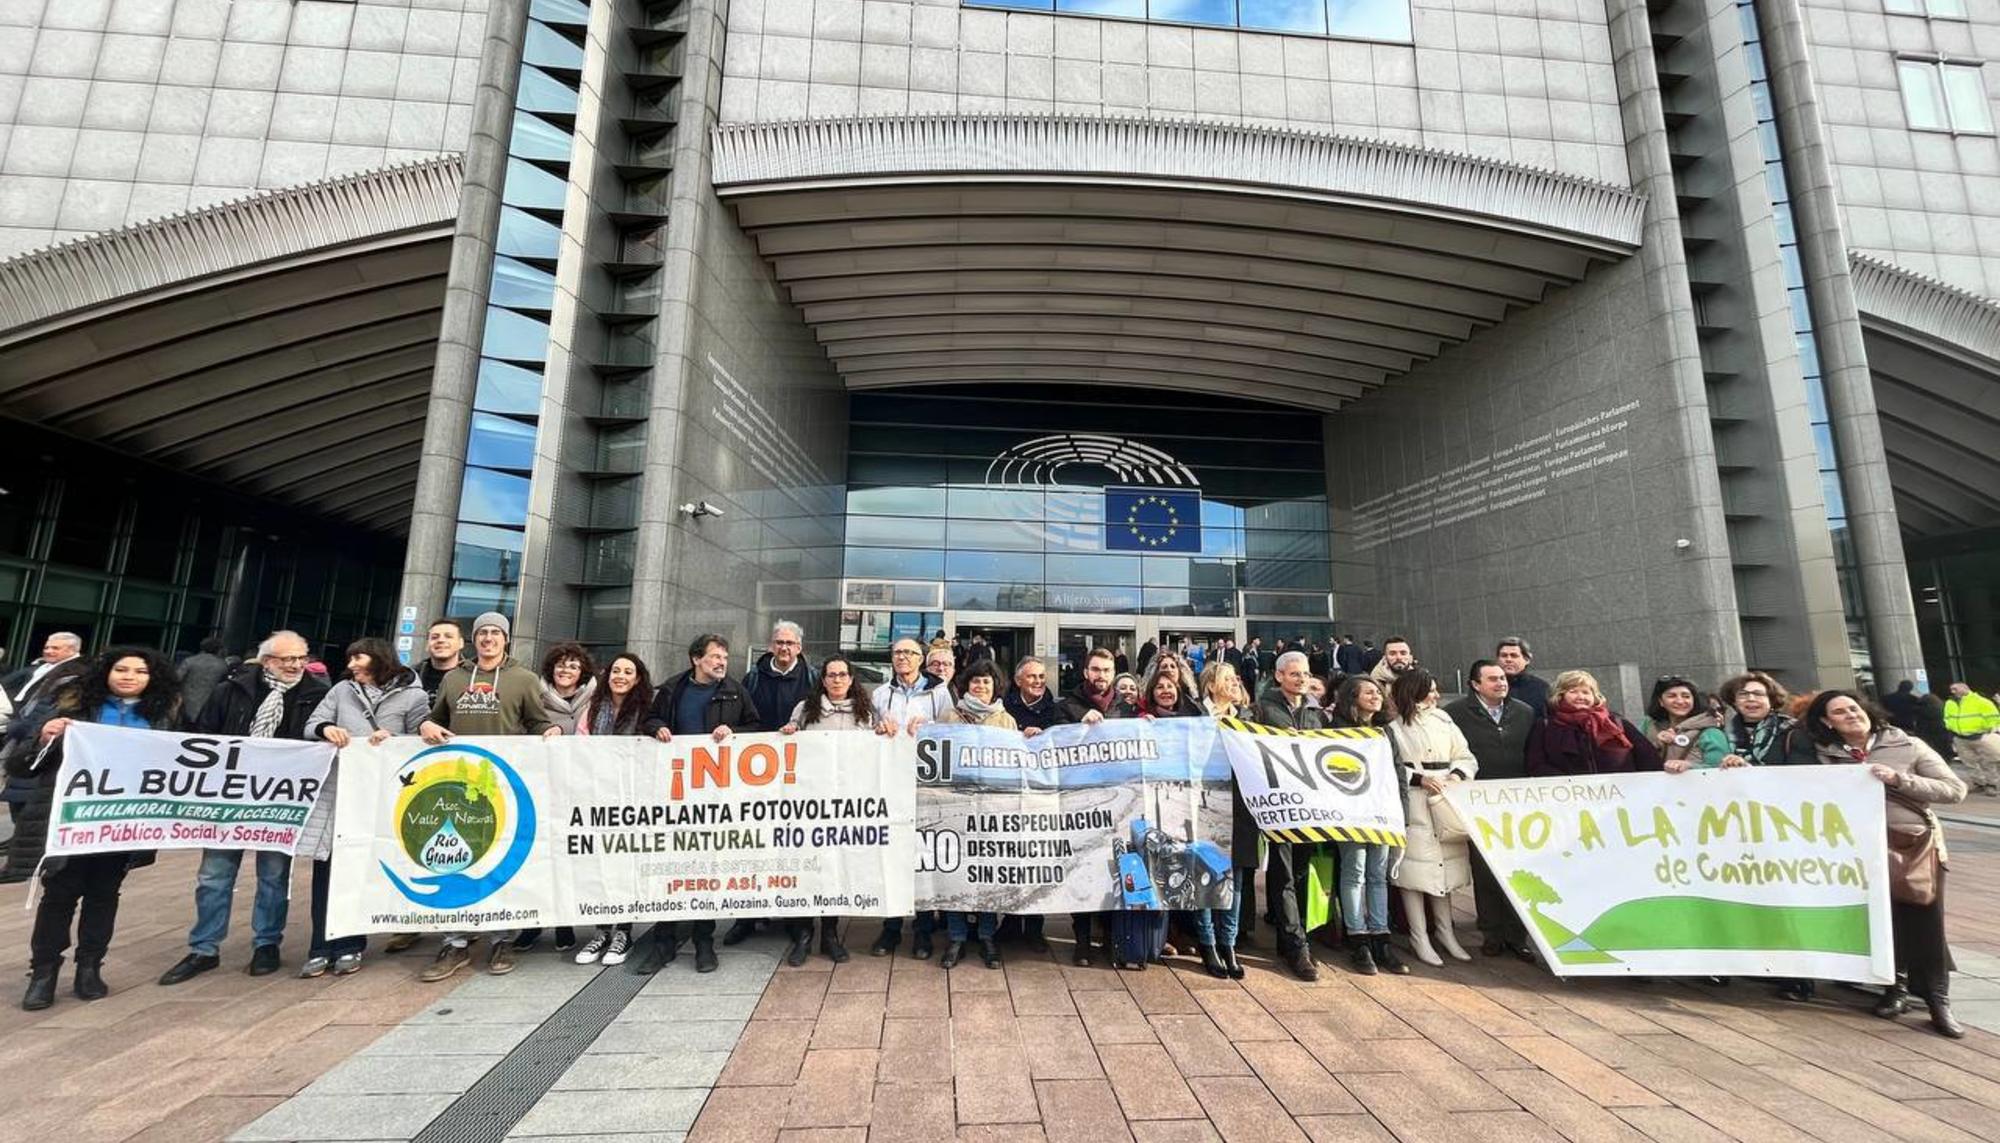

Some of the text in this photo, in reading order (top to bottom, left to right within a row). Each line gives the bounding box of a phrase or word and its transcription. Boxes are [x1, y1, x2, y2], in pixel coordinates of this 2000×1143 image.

[1600, 399, 1640, 419] Parlament
[175, 738, 243, 770] Sí
[916, 738, 951, 782] SI
[960, 739, 1159, 770] AL RELEVO GENERACIONAL
[670, 742, 798, 800] ¡NO!
[1254, 740, 1371, 796] NO
[64, 769, 319, 802] AL BULEVAR
[1469, 784, 1625, 806] PLATAFORMA
[570, 797, 889, 827] A MEGAPLANTA FOTOVOLTAICA
[1246, 792, 1304, 809] MACRO
[74, 803, 306, 822] NAVALMORAL VERDE Y ACCESIBLE
[408, 811, 439, 825] Valle
[967, 809, 1113, 833] A LA ESPECULACIÓN
[58, 828, 94, 846] Tren
[99, 823, 166, 842] Público,
[172, 823, 217, 841] Social
[220, 831, 228, 842] y
[1474, 801, 1856, 851] NO A LA MINA
[434, 833, 459, 848] Río
[567, 824, 889, 854] EN VALLE NATURAL RÍO GRANDE
[967, 839, 1073, 858] DESTRUCTIVA
[425, 850, 470, 866] Grande
[915, 829, 961, 873] NO
[968, 865, 1064, 884] SIN SENTIDO
[1655, 853, 1870, 891] de Cañaveral
[667, 879, 721, 894] ¡PERO
[726, 874, 762, 892] ASÍ,
[371, 907, 539, 926] www.vallenaturalriogrande.com
[579, 903, 625, 916] Vecinos
[628, 900, 687, 914] afectados:
[854, 895, 879, 909] Ojén
